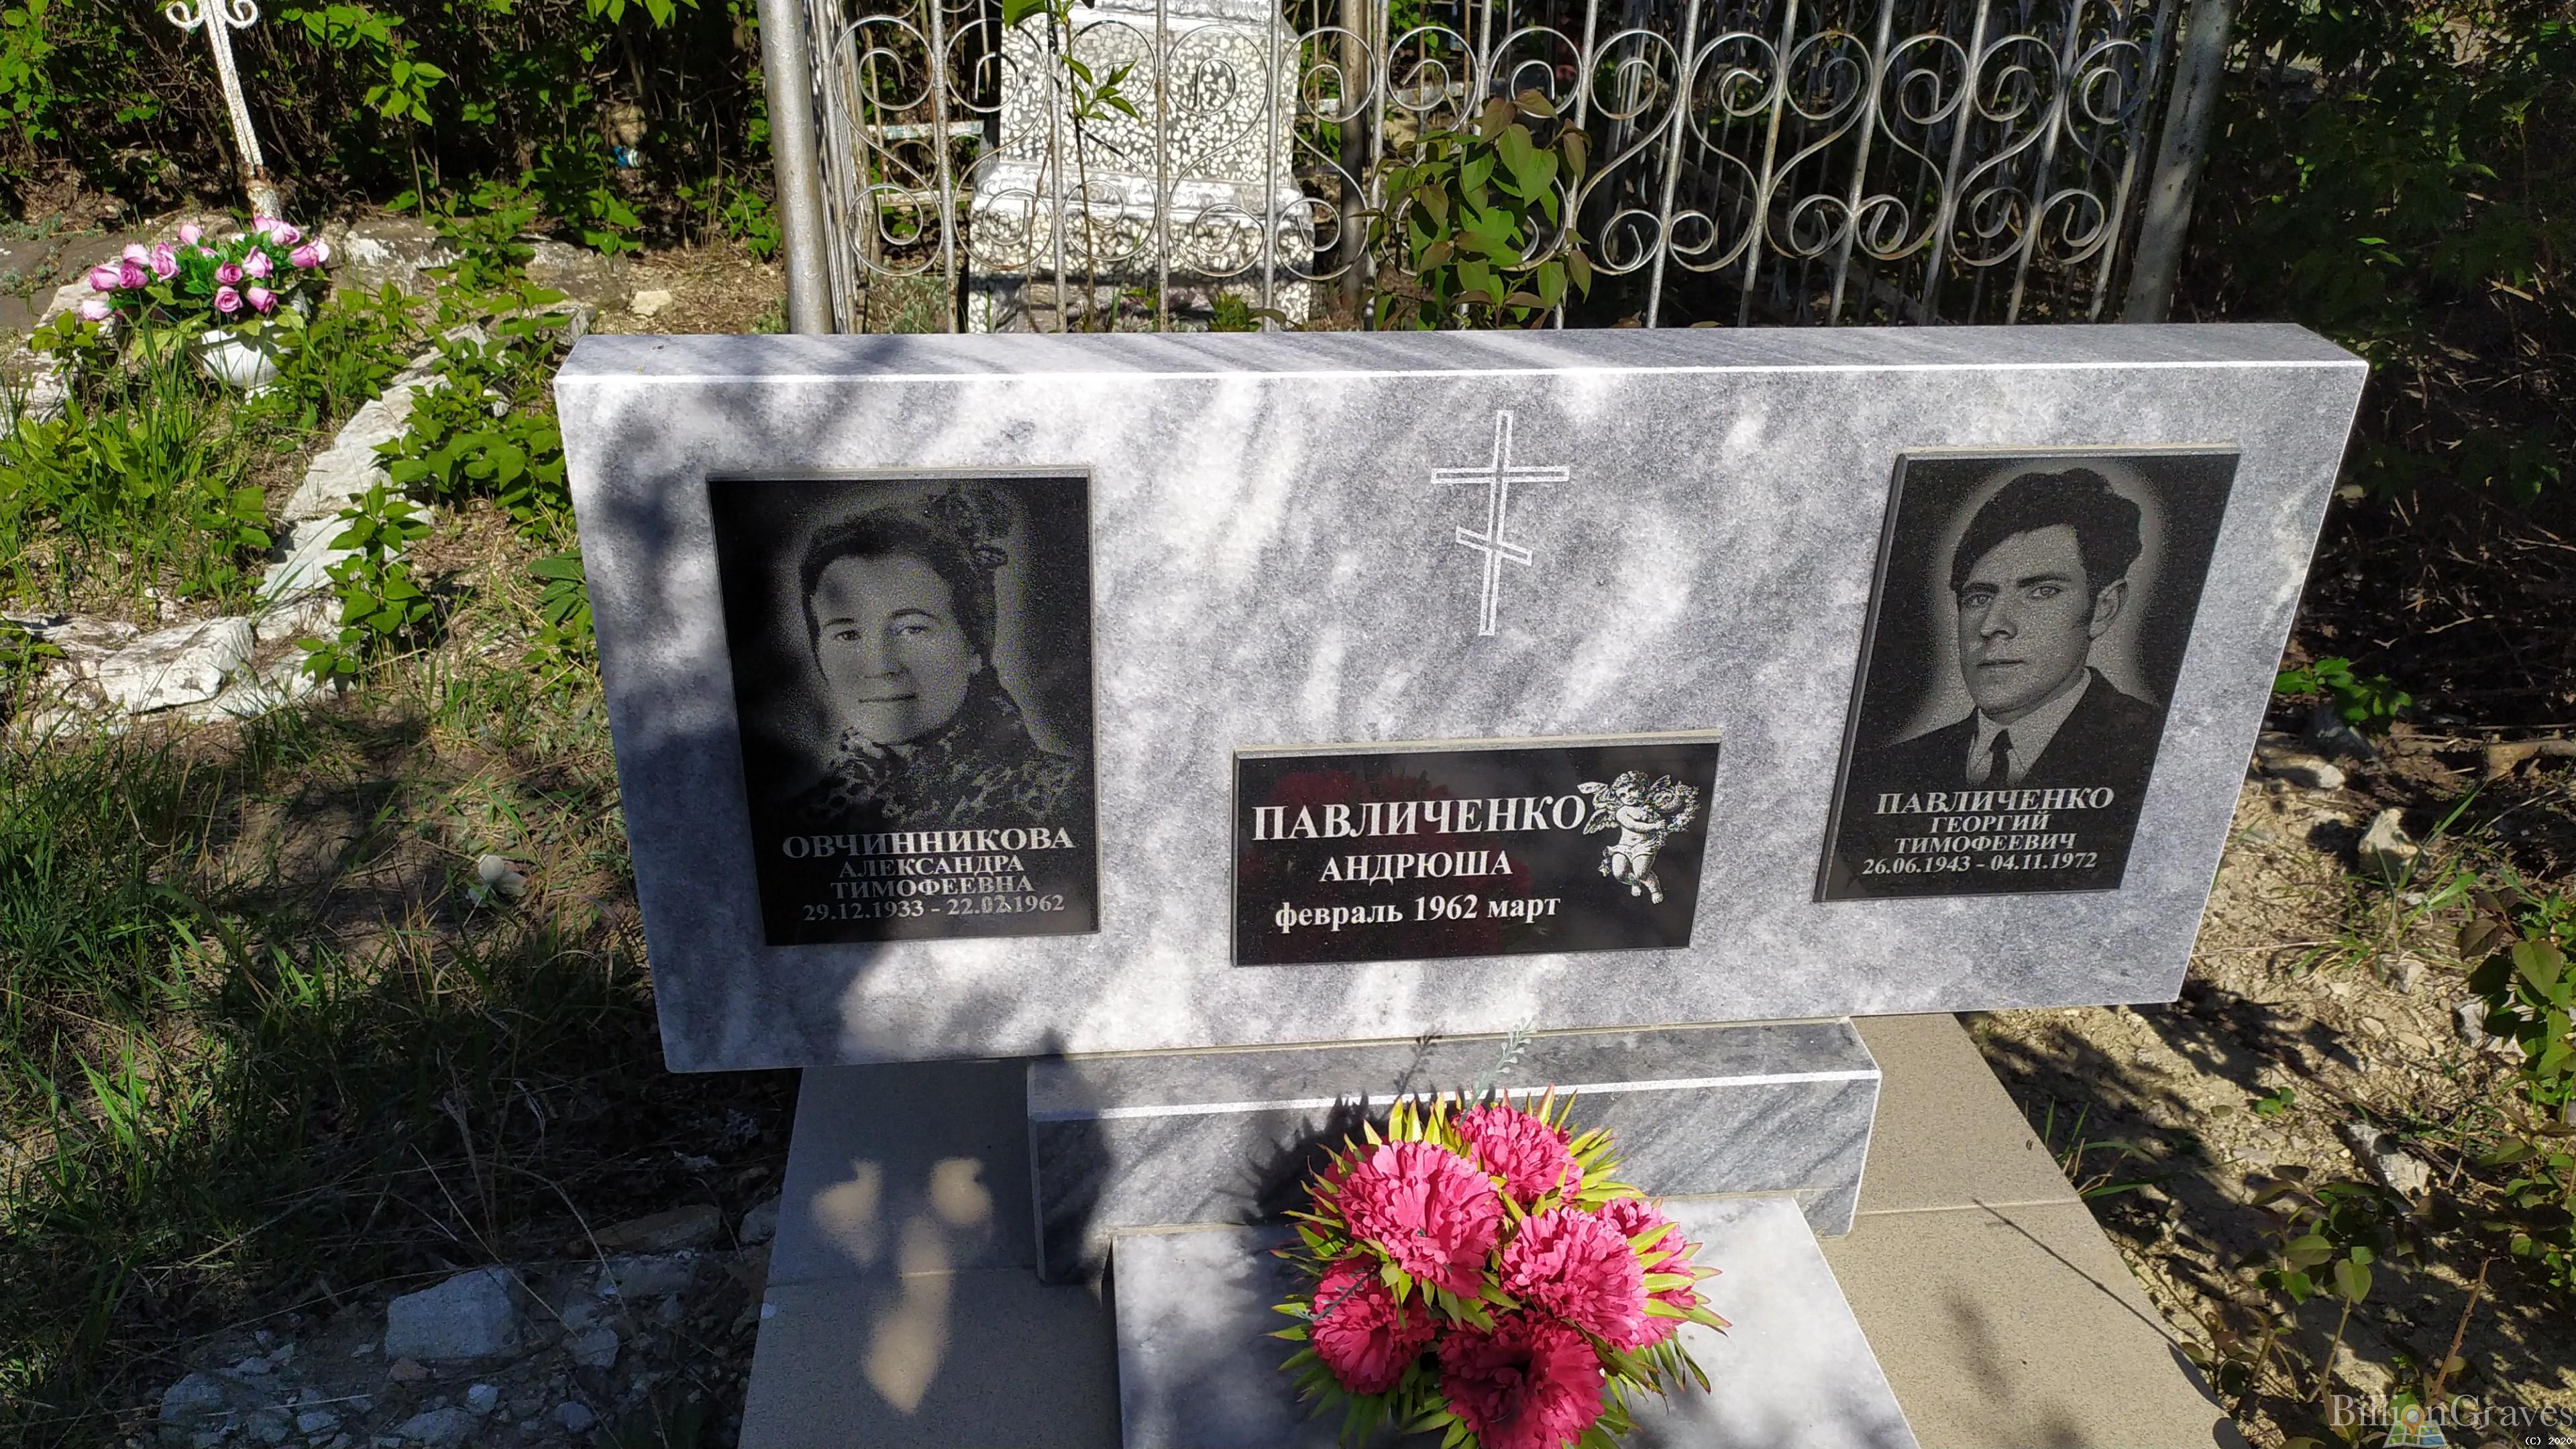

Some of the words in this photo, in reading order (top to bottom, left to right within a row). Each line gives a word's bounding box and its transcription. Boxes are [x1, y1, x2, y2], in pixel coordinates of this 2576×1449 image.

[1874, 786, 2115, 815] ПАВЛИЧЕНКО
[1251, 794, 1585, 841] ПАВЛИЧЕНКО
[1929, 810, 2052, 834] ГЕОРГИЙ
[782, 826, 1076, 859] ОВЧИННИКОВА
[1894, 833, 2078, 855] ТИМОФЕЕВИЧ
[839, 855, 1025, 878] АЛЕКСАНДРА
[1318, 850, 1513, 885] АНДРЮША
[1862, 855, 1971, 875] 26.06.1943
[1990, 851, 2098, 871] 04.11.1972
[830, 875, 1036, 900] ТИМОФЕЕВНА
[804, 899, 924, 921] 29.12.1933
[1275, 901, 1403, 934] февраль
[1414, 894, 1479, 922] 1962
[1487, 896, 1562, 926] март
